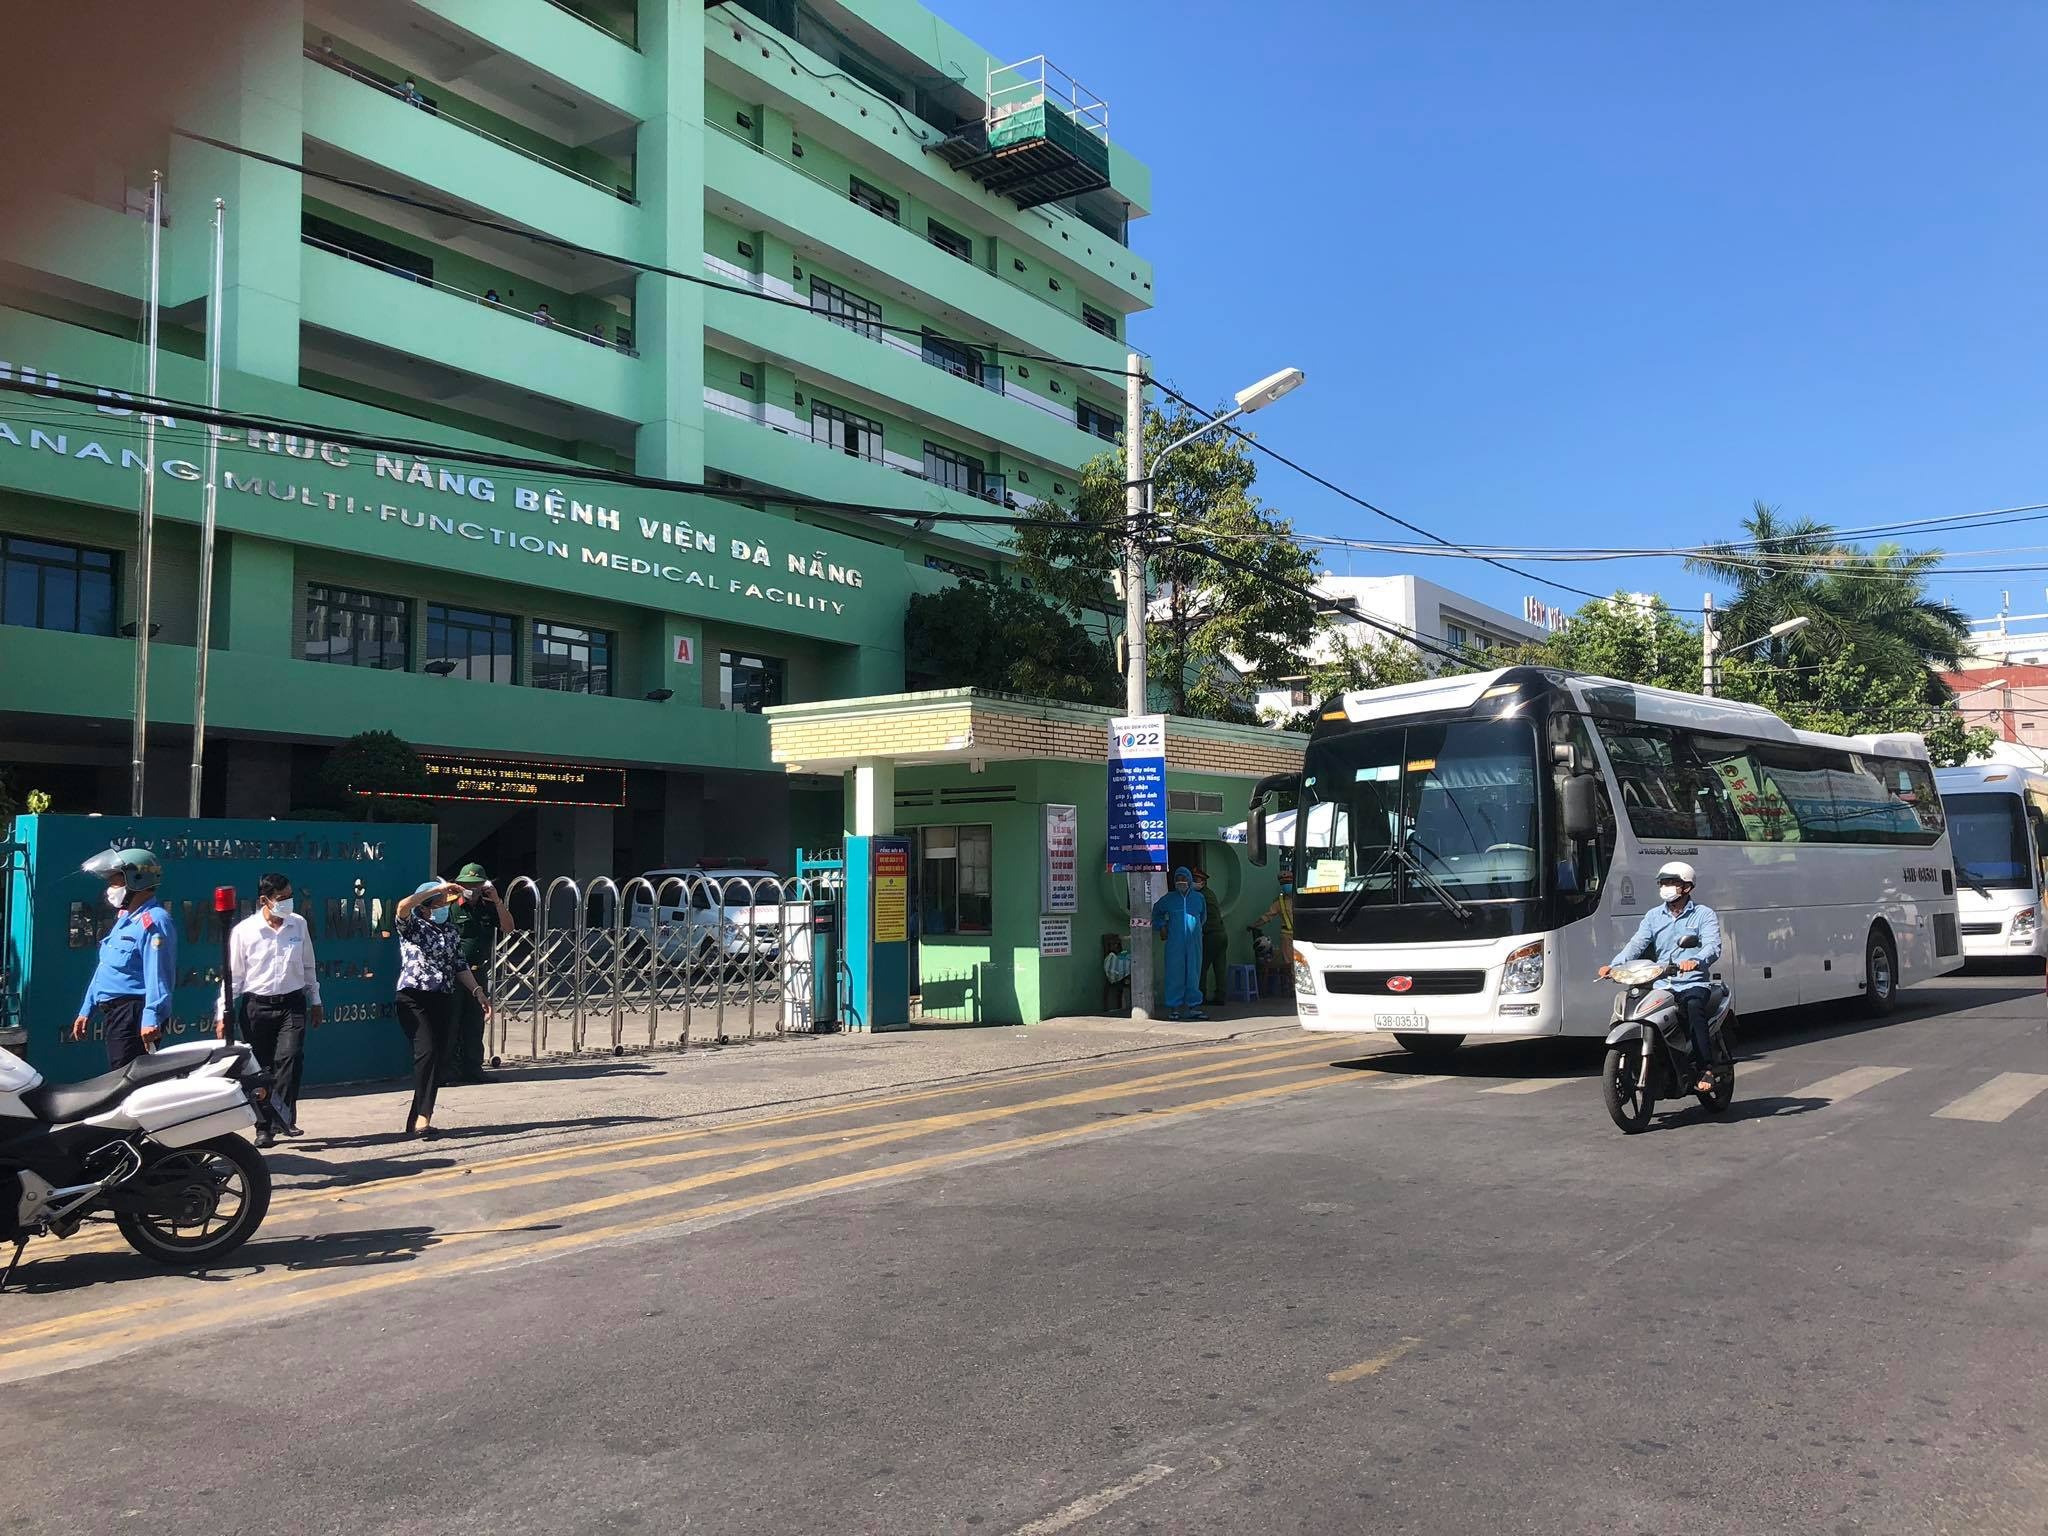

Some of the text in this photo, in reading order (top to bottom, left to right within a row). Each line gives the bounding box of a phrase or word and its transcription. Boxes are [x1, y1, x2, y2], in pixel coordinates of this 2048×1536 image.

[376, 452, 496, 502] NĂNG
[515, 486, 621, 531] BỆNH
[638, 516, 717, 554] VIỆN
[731, 538, 771, 568] ĐÀ
[787, 551, 864, 588] NẴNG
[581, 547, 719, 590] MEDICAL
[729, 579, 846, 615] FACILITY
[677, 638, 690, 662] A
[1376, 1015, 1424, 1028] 43B-035.31
